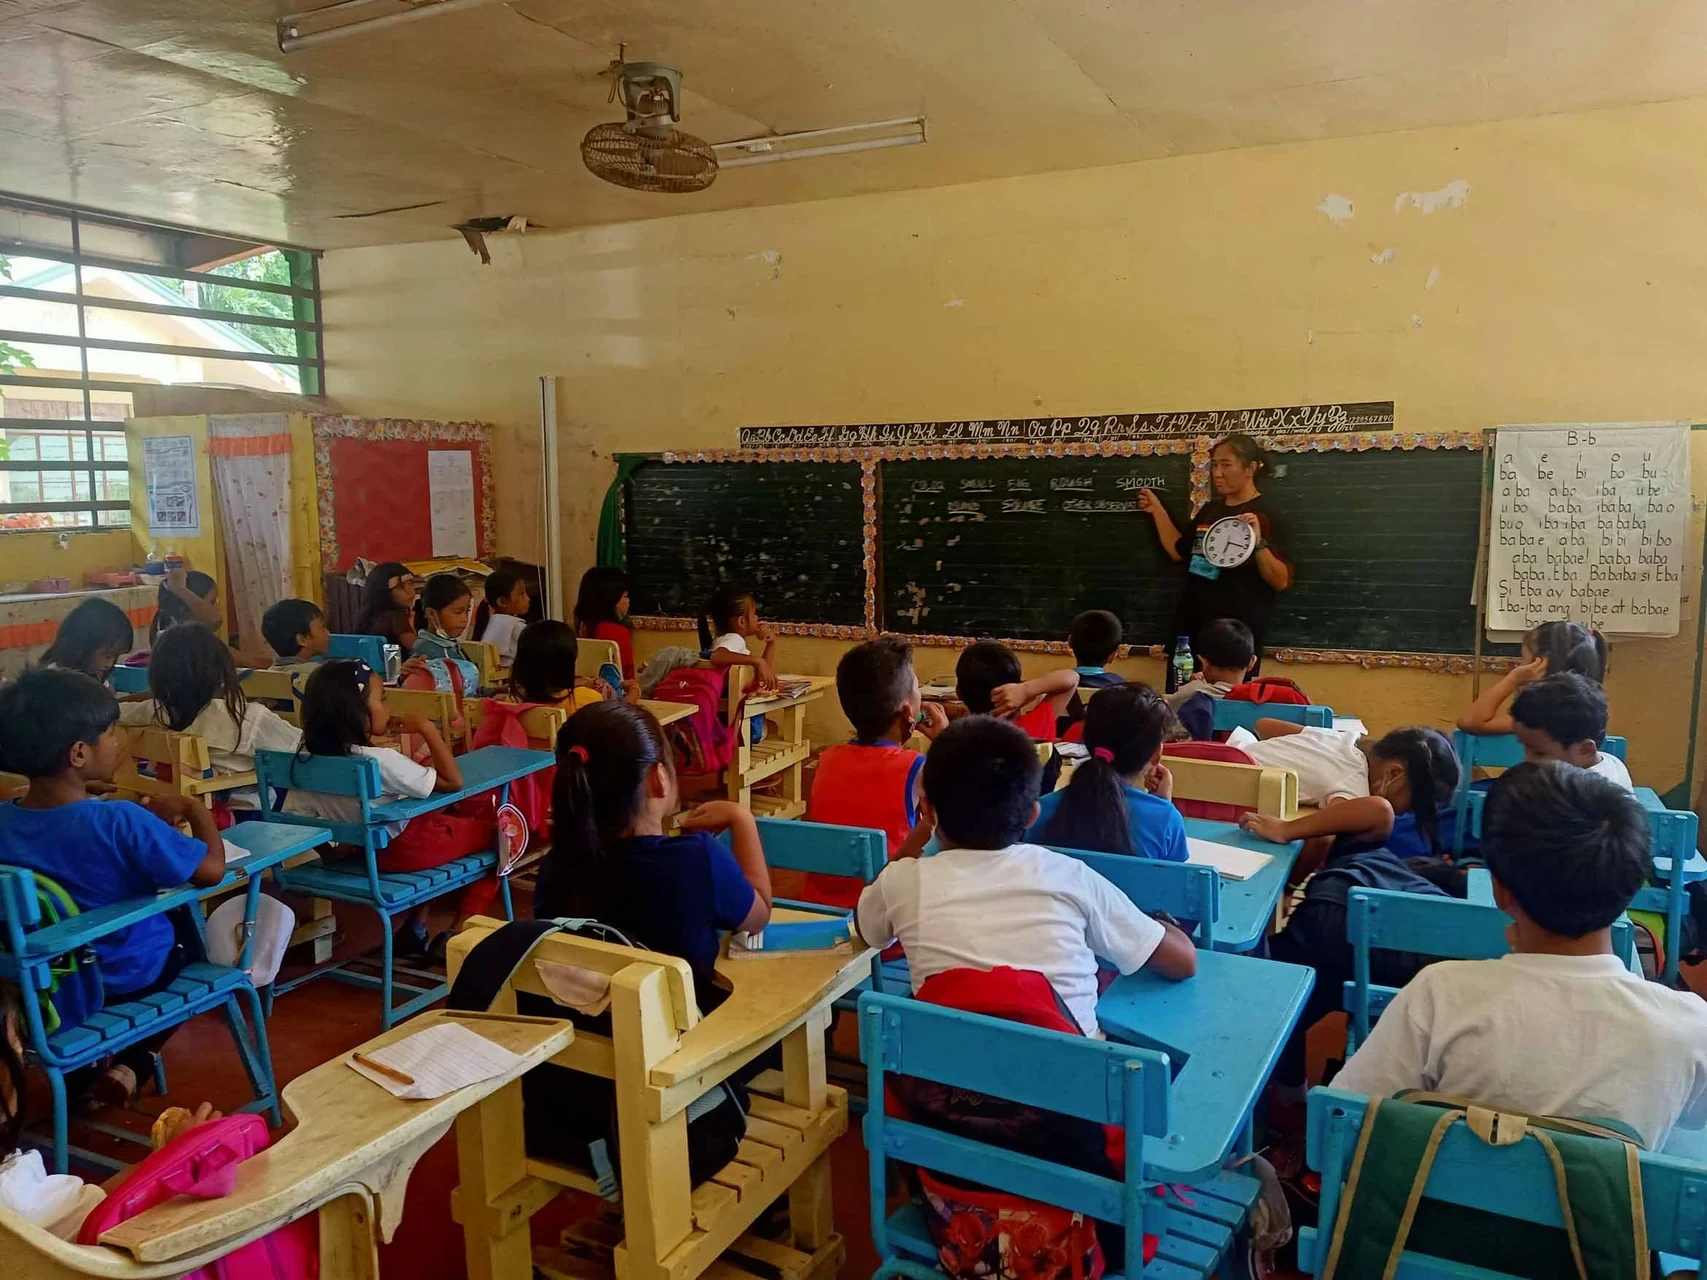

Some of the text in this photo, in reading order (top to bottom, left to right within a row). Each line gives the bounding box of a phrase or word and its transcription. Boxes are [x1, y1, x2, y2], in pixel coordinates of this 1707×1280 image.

[1504, 453, 1513, 464] a
[1541, 453, 1549, 463] e
[1611, 453, 1621, 462] o
[1643, 452, 1651, 462] u
[1500, 463, 1657, 480] ba be bi bo bu
[1115, 475, 1166, 489] SMOOTH
[1094, 500, 1138, 510] OBSERVAT
[1500, 514, 1524, 529] buo
[1512, 548, 1668, 565] aba babae! baba baba
[1590, 565, 1636, 580] Bababa
[1640, 571, 1650, 581] si
[1656, 565, 1679, 581] Eba
[1499, 580, 1512, 596] Si
[1520, 580, 1542, 597] Eba
[1546, 588, 1564, 599] ay
[1498, 595, 1542, 612] Iba-iba
[1548, 604, 1571, 619] ang
[1581, 598, 1608, 615] bibe
[1611, 599, 1626, 614] at
[1631, 598, 1669, 615] babae
